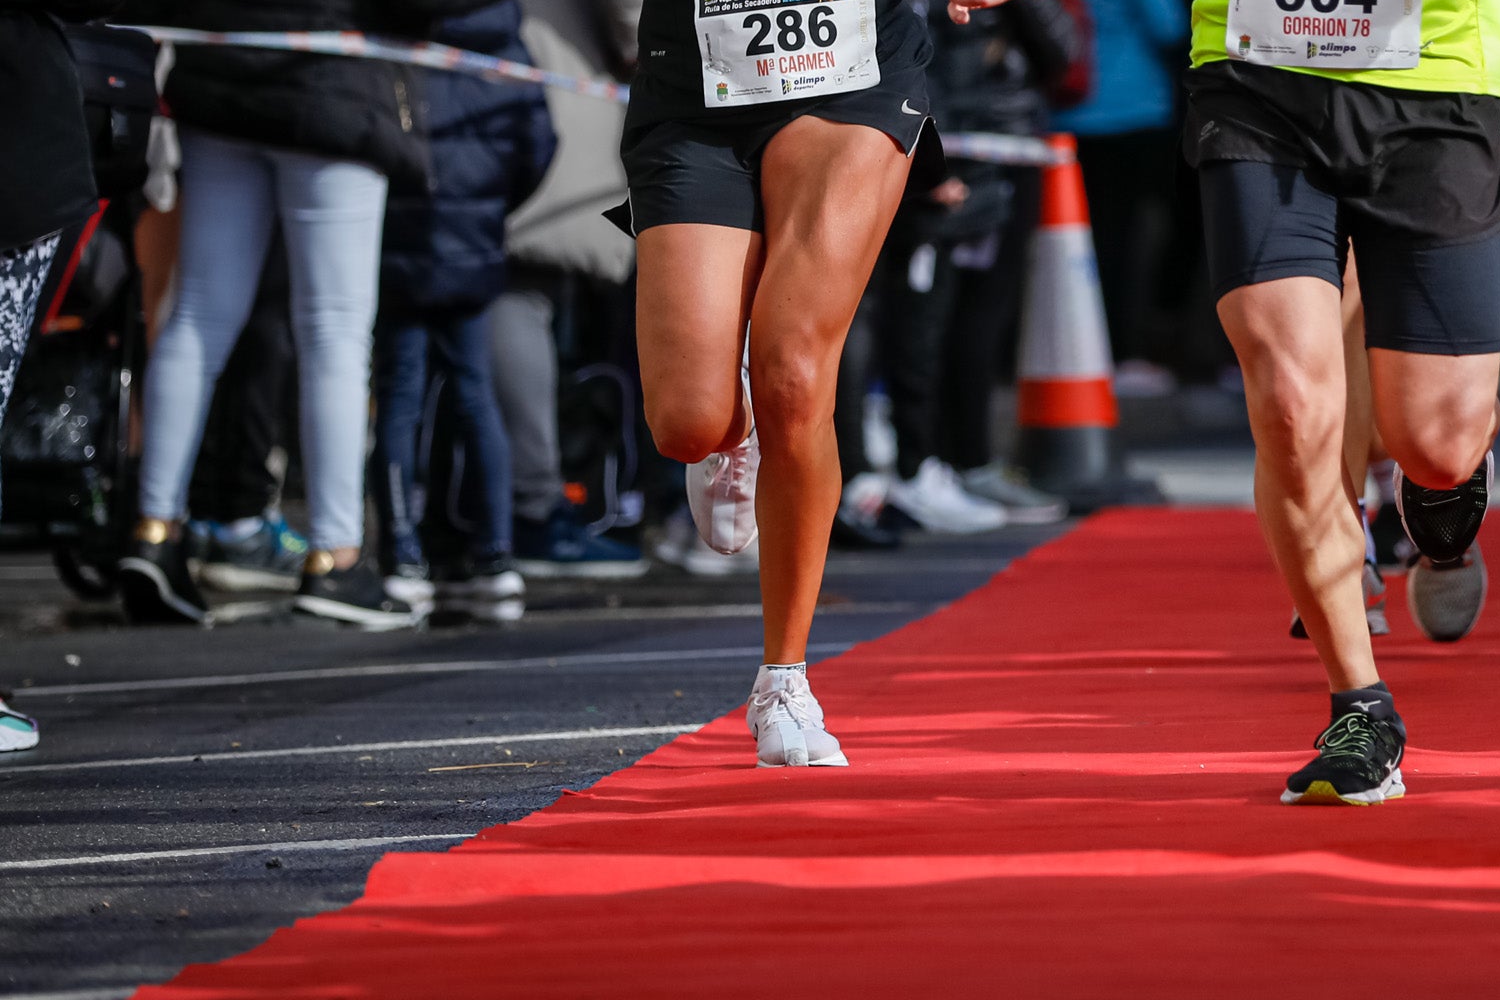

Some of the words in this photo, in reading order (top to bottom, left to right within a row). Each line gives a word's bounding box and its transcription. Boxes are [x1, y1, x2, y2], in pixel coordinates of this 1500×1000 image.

[704, 4, 720, 14] Ruta
[721, 3, 731, 11] de
[732, 1, 742, 10] los
[742, 5, 838, 57] 286
[1283, 16, 1346, 37] GORRION
[1351, 18, 1370, 37] 78
[1321, 43, 1357, 53] olimpo
[779, 51, 835, 74] CARMEN
[794, 75, 826, 85] olimpo
